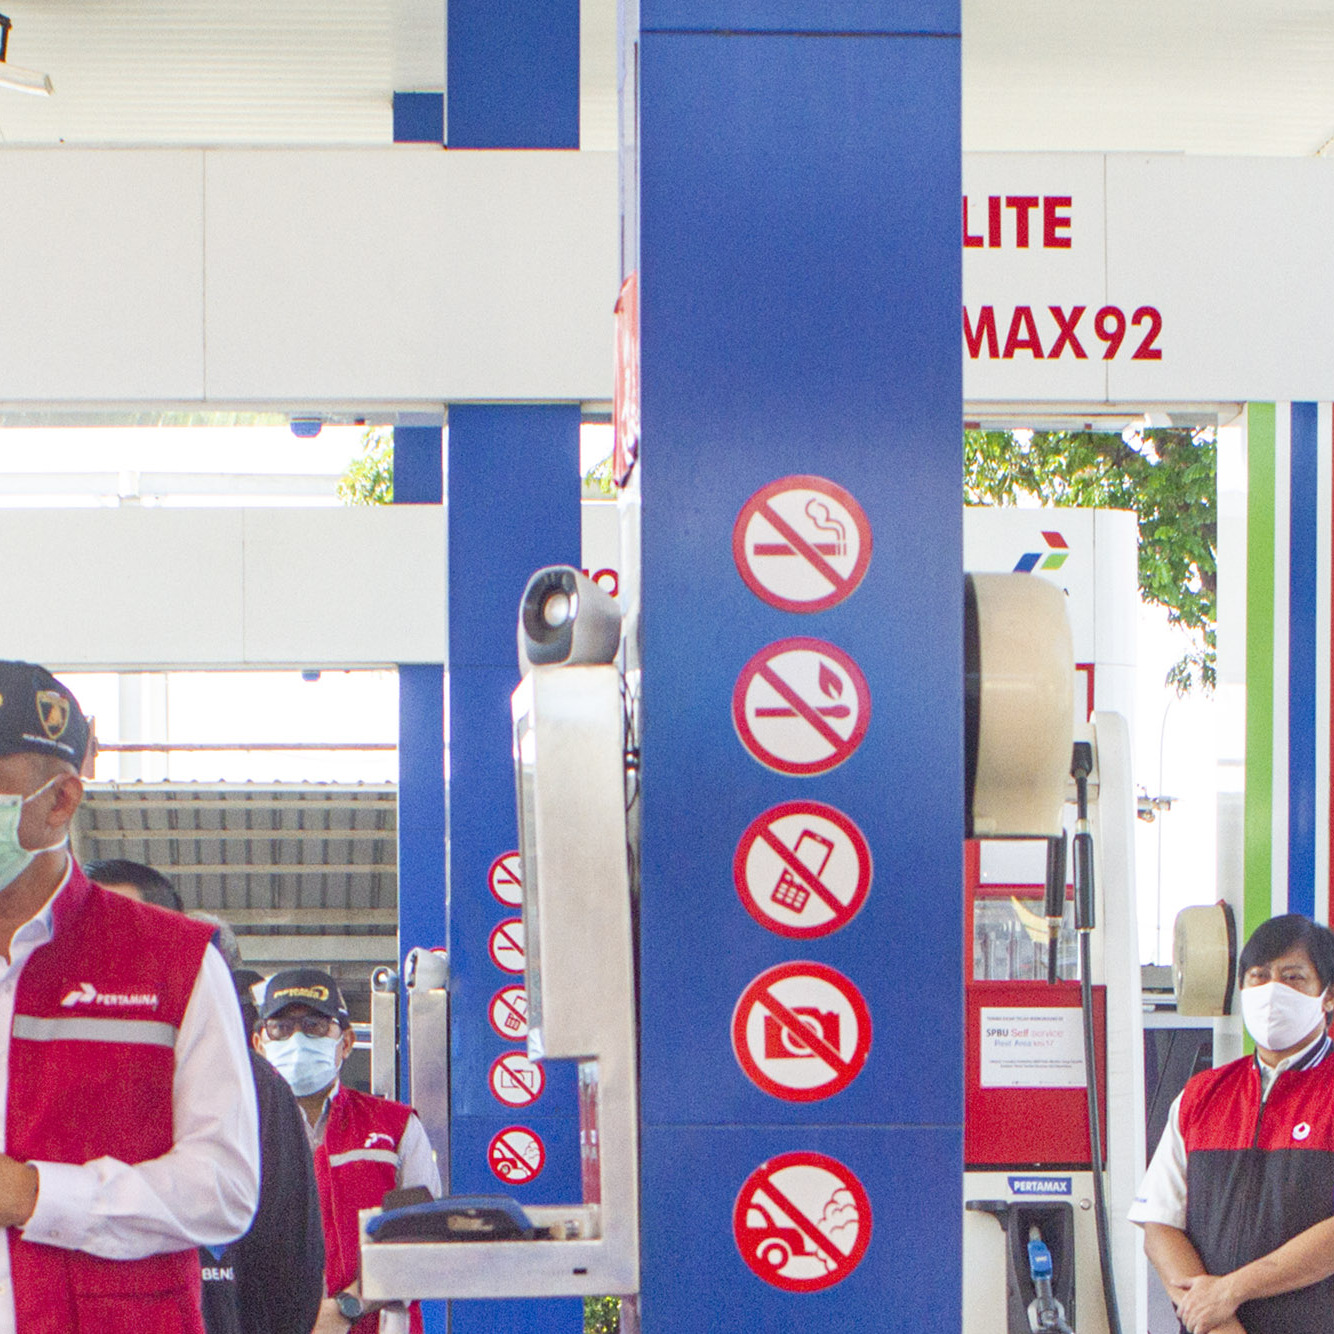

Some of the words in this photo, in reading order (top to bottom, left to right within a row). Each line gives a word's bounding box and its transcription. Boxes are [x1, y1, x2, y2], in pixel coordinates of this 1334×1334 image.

[963, 196, 1072, 249] LITE
[963, 305, 1163, 361] MAX92
[96, 994, 158, 1006] PERTAMINA
[986, 1028, 1009, 1037] SPBU
[1013, 1181, 1068, 1192] PERTAMAX
